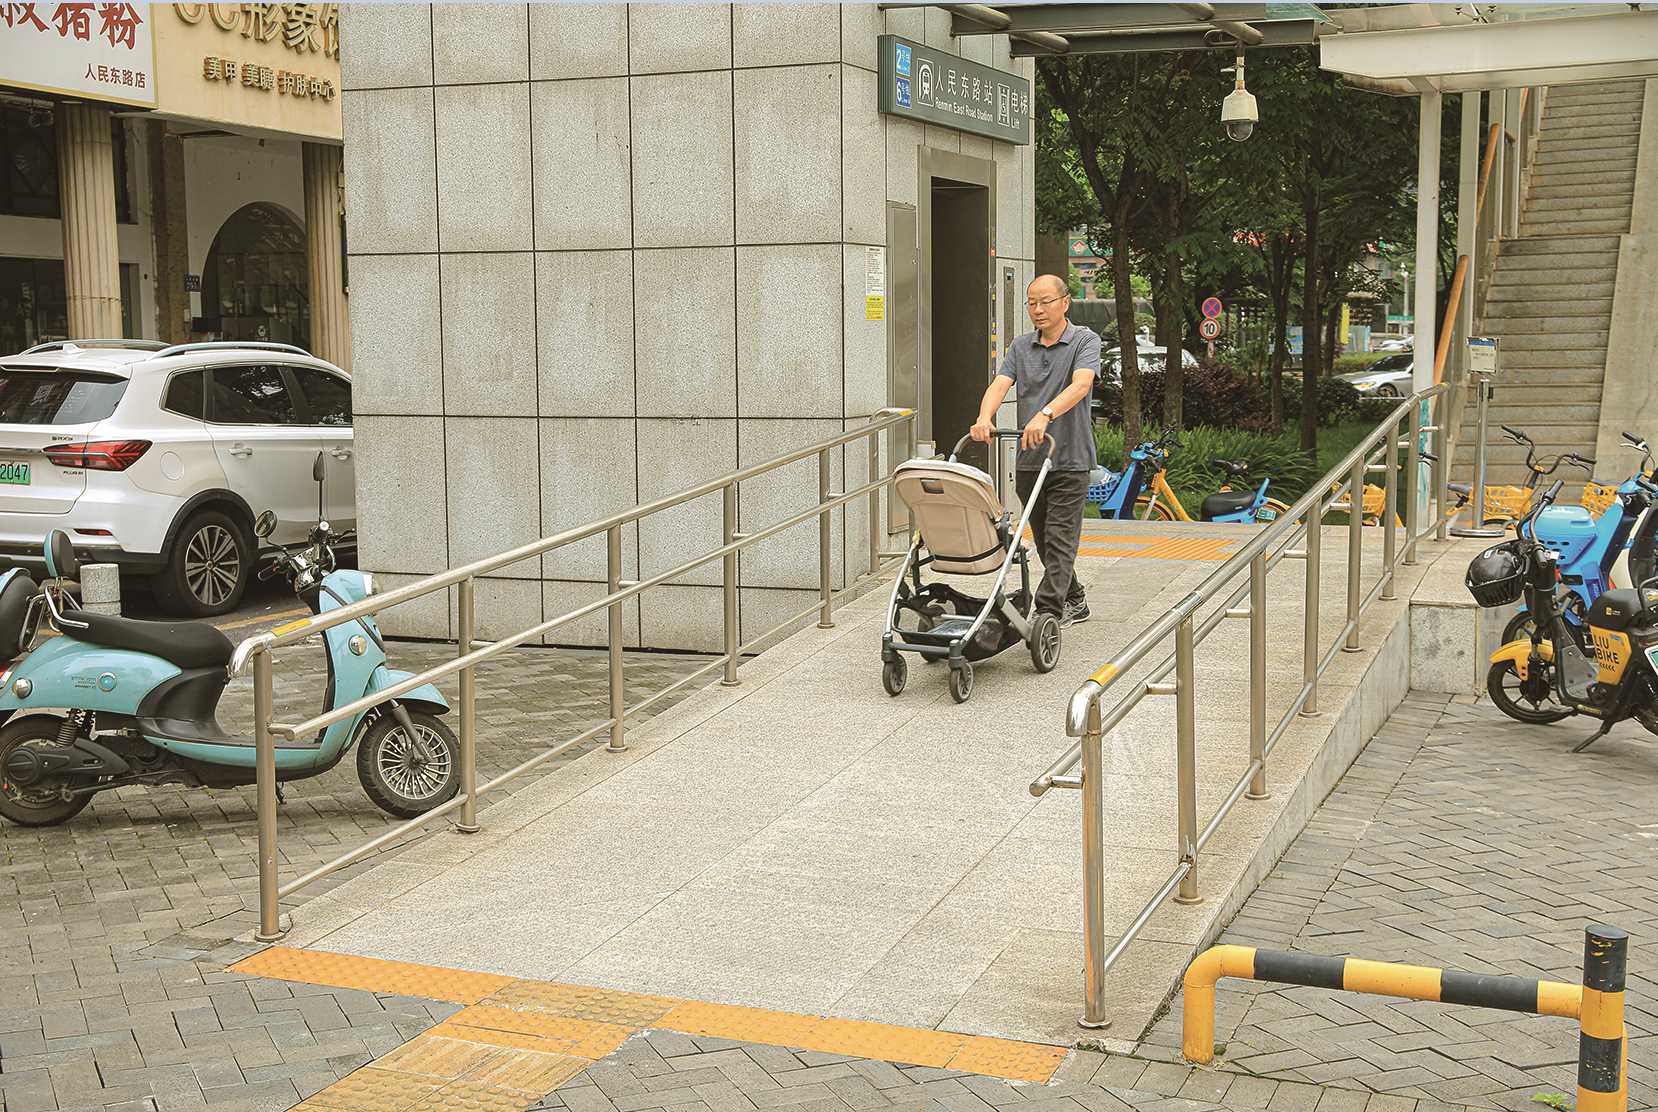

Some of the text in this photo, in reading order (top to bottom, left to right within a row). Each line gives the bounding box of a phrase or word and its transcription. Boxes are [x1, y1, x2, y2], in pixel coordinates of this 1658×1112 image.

[85, 63, 146, 88] 人民东路店
[203, 56, 237, 85] 美甲
[935, 65, 993, 105] 人民东路站
[953, 101, 965, 116] East
[965, 105, 977, 118] Road
[977, 108, 993, 122] Station
[1204, 323, 1216, 335] 10
[0, 463, 28, 481] 2047
[1594, 634, 1610, 649] LIU
[1597, 648, 1620, 665] BIKE
